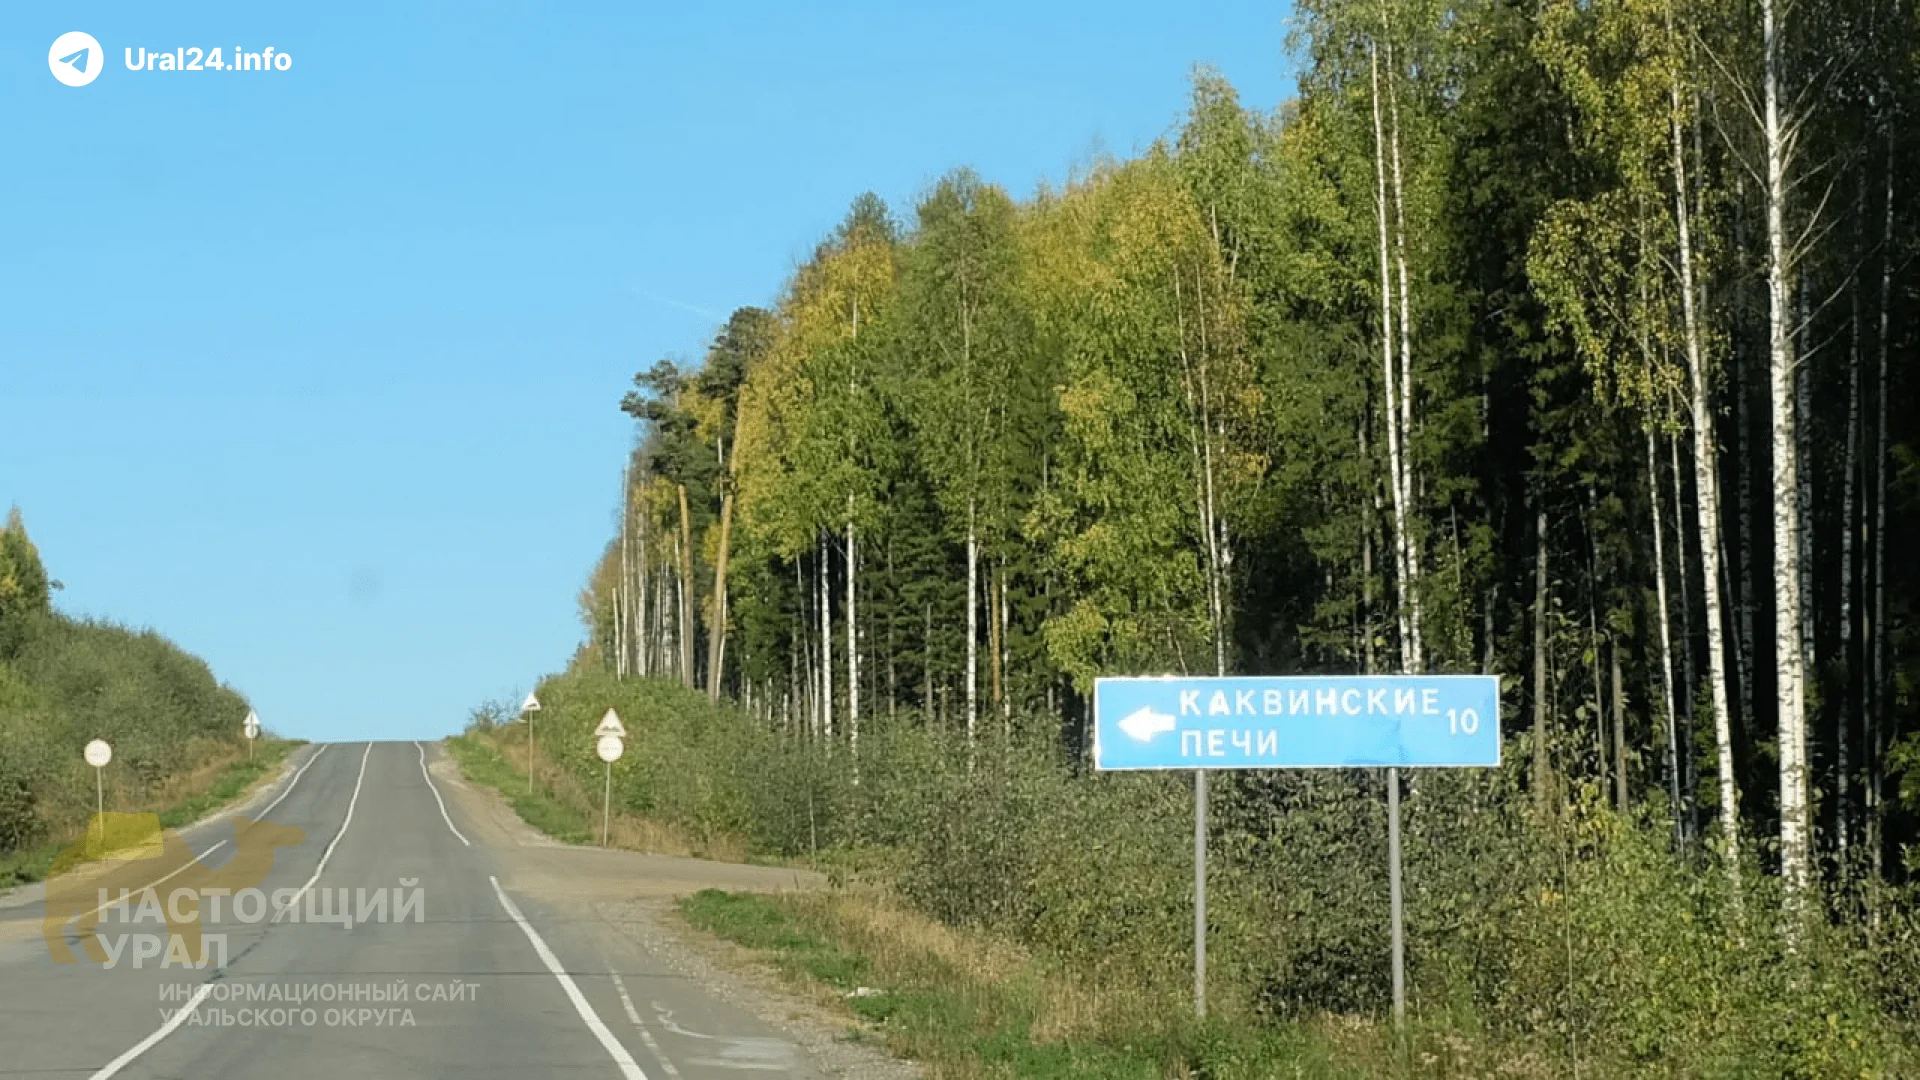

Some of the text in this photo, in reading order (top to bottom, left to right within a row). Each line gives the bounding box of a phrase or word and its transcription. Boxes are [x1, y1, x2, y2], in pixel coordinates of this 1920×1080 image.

[1179, 688, 1440, 716] КАКВИНСКИЕ
[1446, 708, 1479, 735] 10
[1181, 729, 1279, 757] ПЕЧИ
